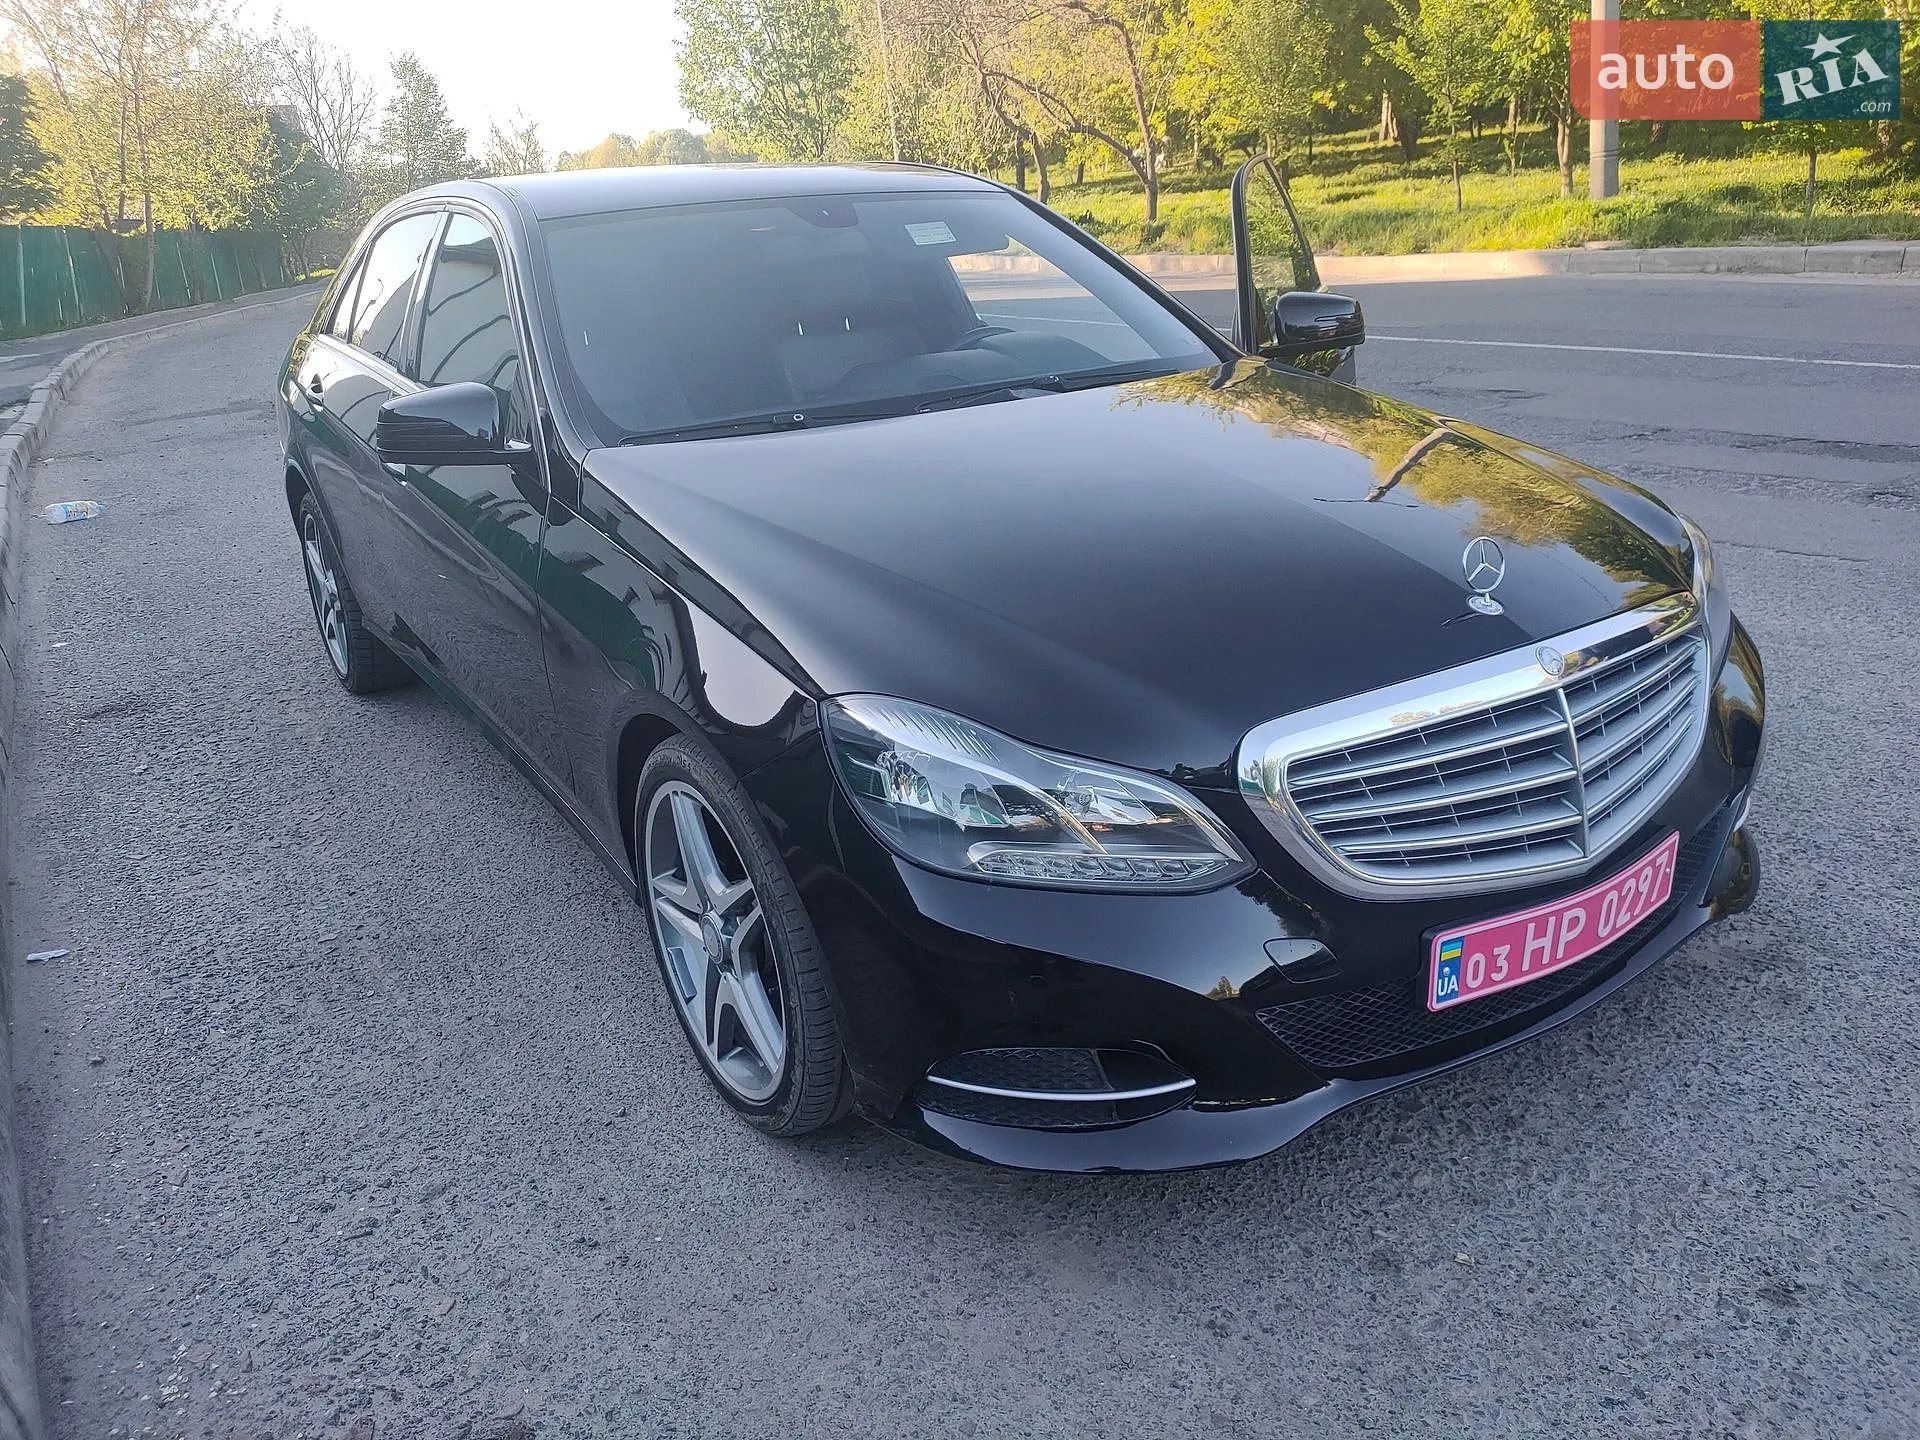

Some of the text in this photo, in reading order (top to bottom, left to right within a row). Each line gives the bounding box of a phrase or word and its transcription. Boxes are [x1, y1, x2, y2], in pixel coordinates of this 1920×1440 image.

[1465, 851, 1669, 989] 03 HP 0297
[1437, 976, 1459, 996] UA
